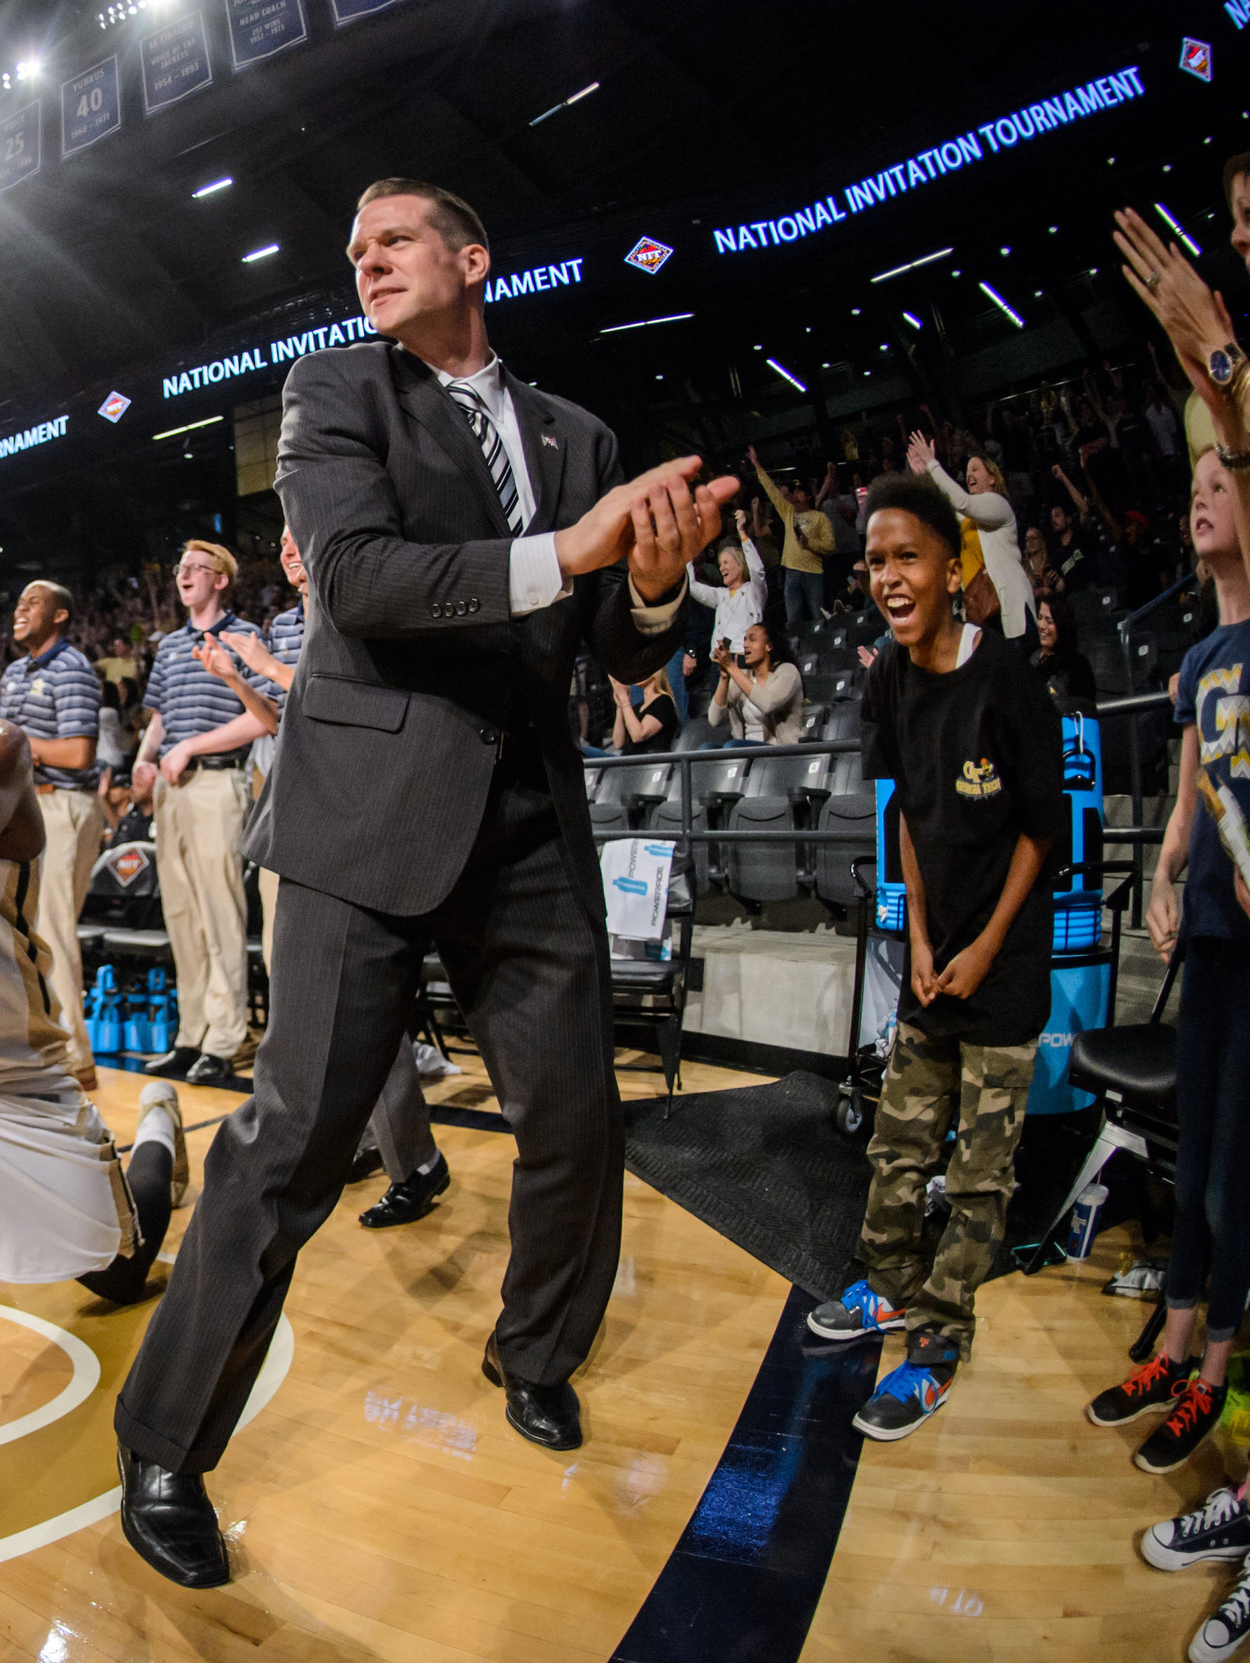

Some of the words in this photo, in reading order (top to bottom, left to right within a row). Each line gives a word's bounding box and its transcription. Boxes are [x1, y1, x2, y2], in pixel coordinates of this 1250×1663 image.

[239, 12, 259, 26] HEAD
[261, 1, 286, 16] COACH
[72, 67, 105, 93] YUNKUS
[181, 61, 199, 77] 1993
[76, 87, 103, 118] 40
[4, 131, 25, 162] 25
[713, 195, 847, 255] NATIONAL
[845, 131, 984, 214] INVITATION
[979, 65, 1146, 153] TOURNAMENT
[637, 249, 662, 262] NIT
[162, 348, 268, 399] NATIONAL
[270, 316, 378, 364] INVITATIO
[117, 858, 139, 872] NIT
[651, 865, 665, 927] POWERADE
